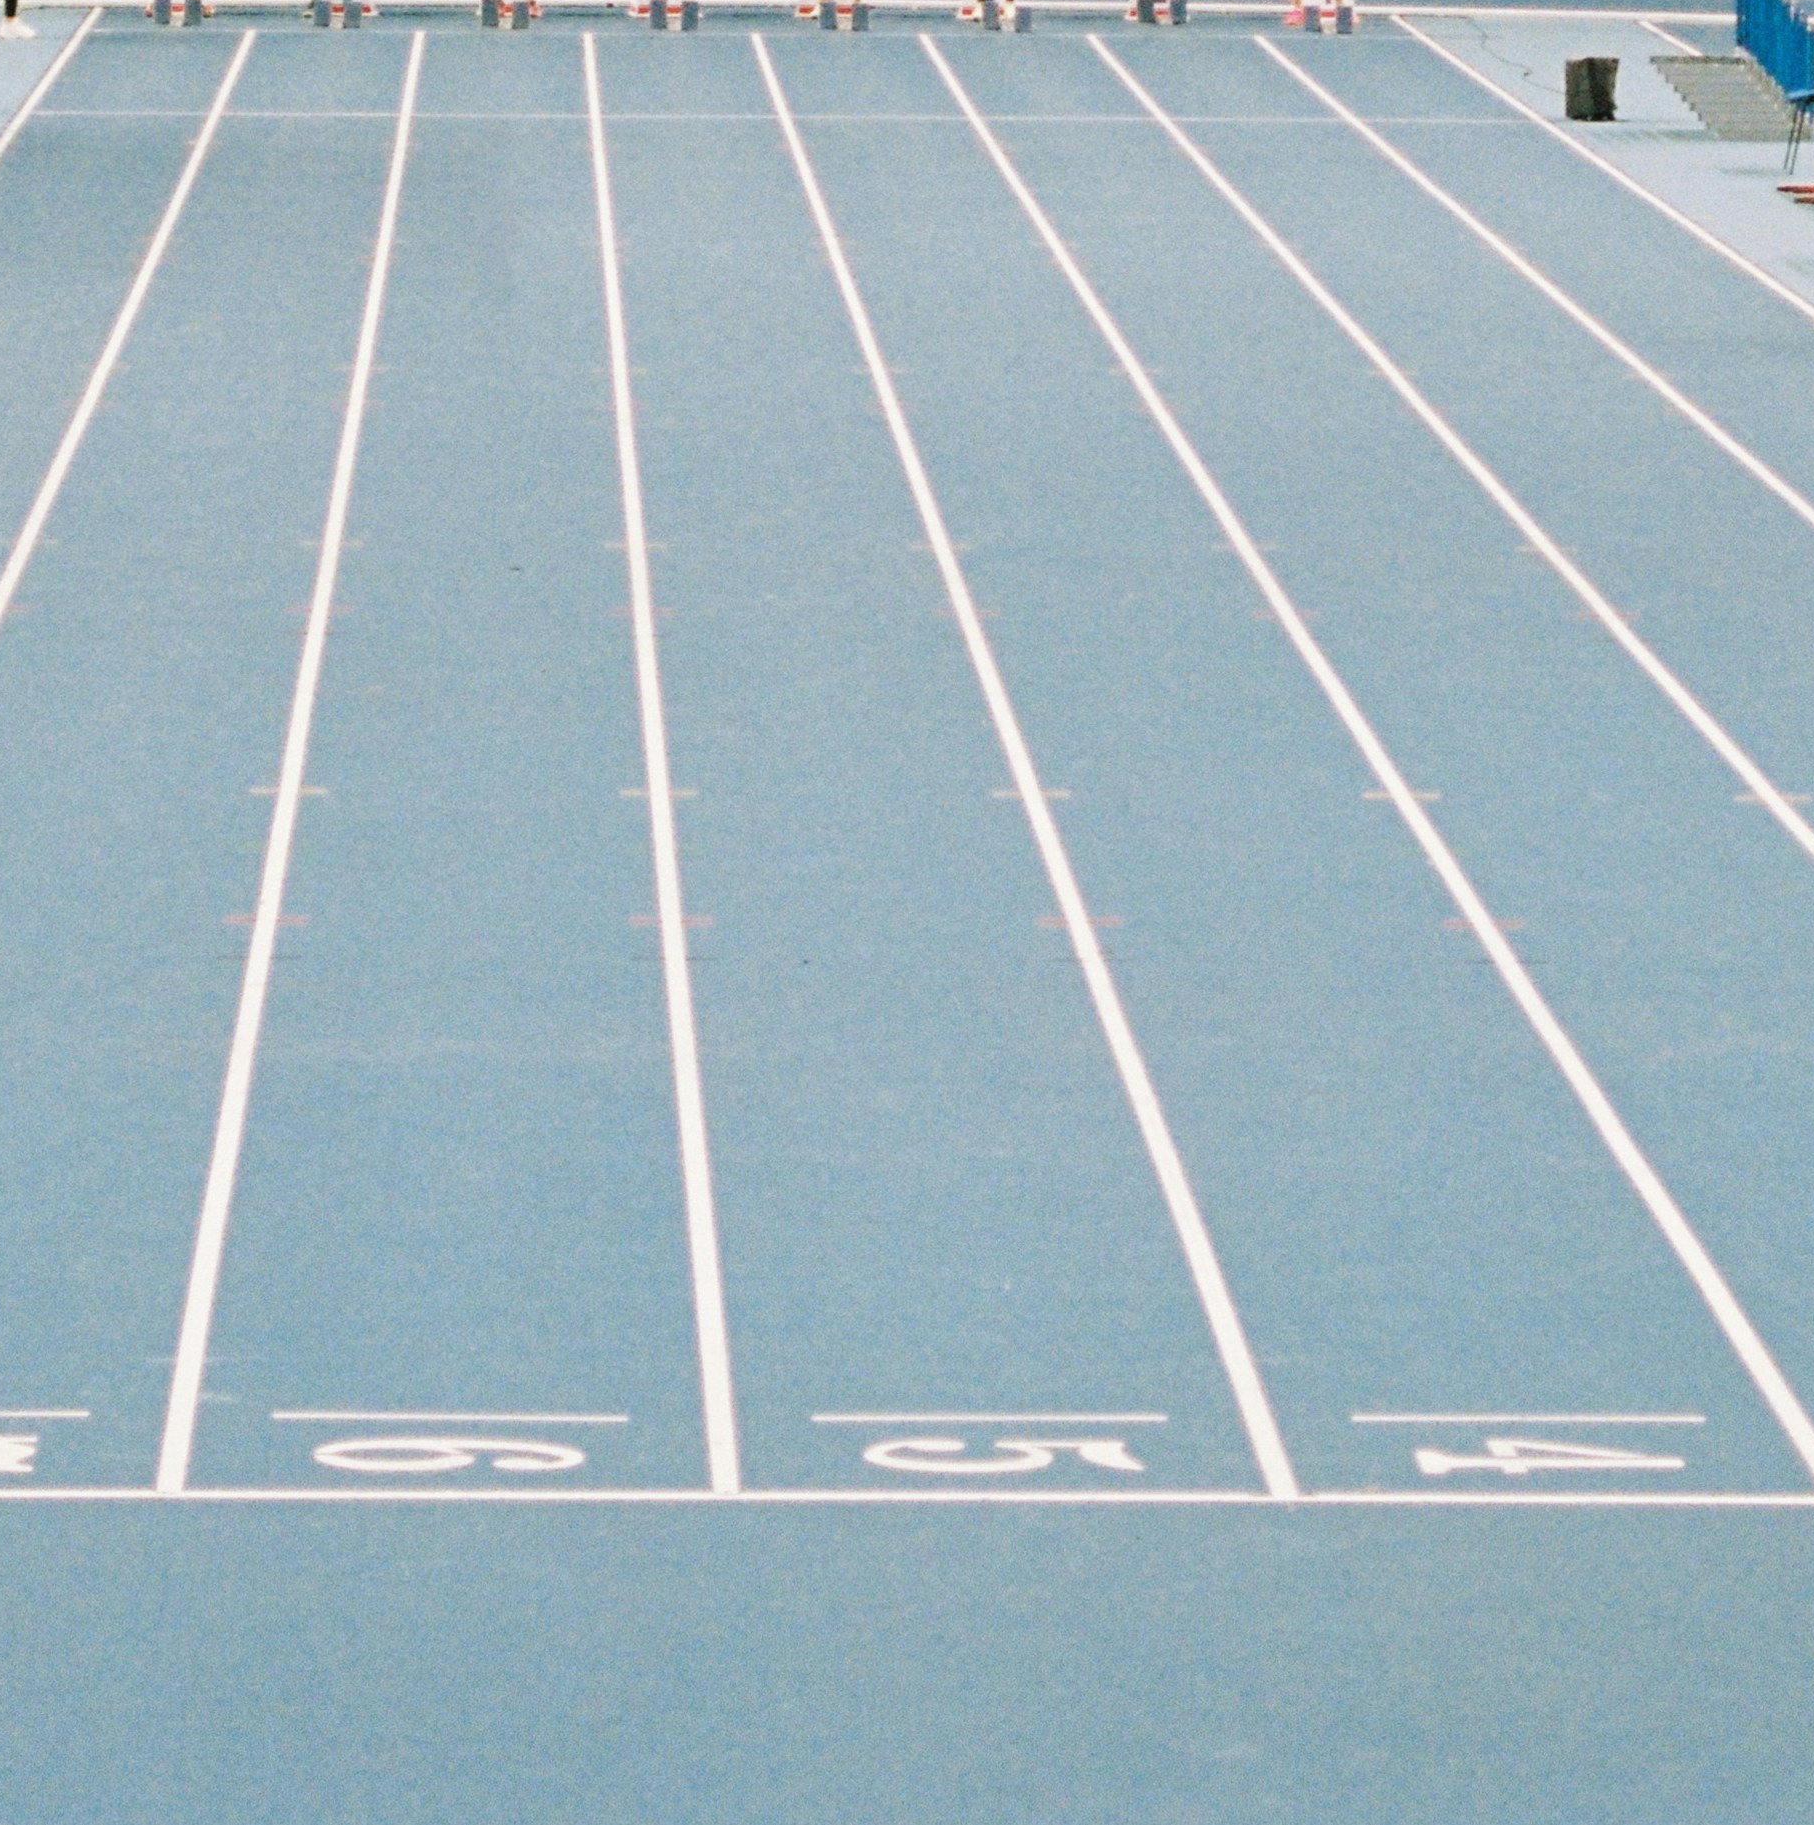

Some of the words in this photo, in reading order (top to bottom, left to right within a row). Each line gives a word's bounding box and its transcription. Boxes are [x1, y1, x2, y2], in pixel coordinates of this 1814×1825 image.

[312, 1437, 586, 1474] 6
[861, 1437, 1146, 1475] 5
[1415, 1438, 1685, 1476] 4
